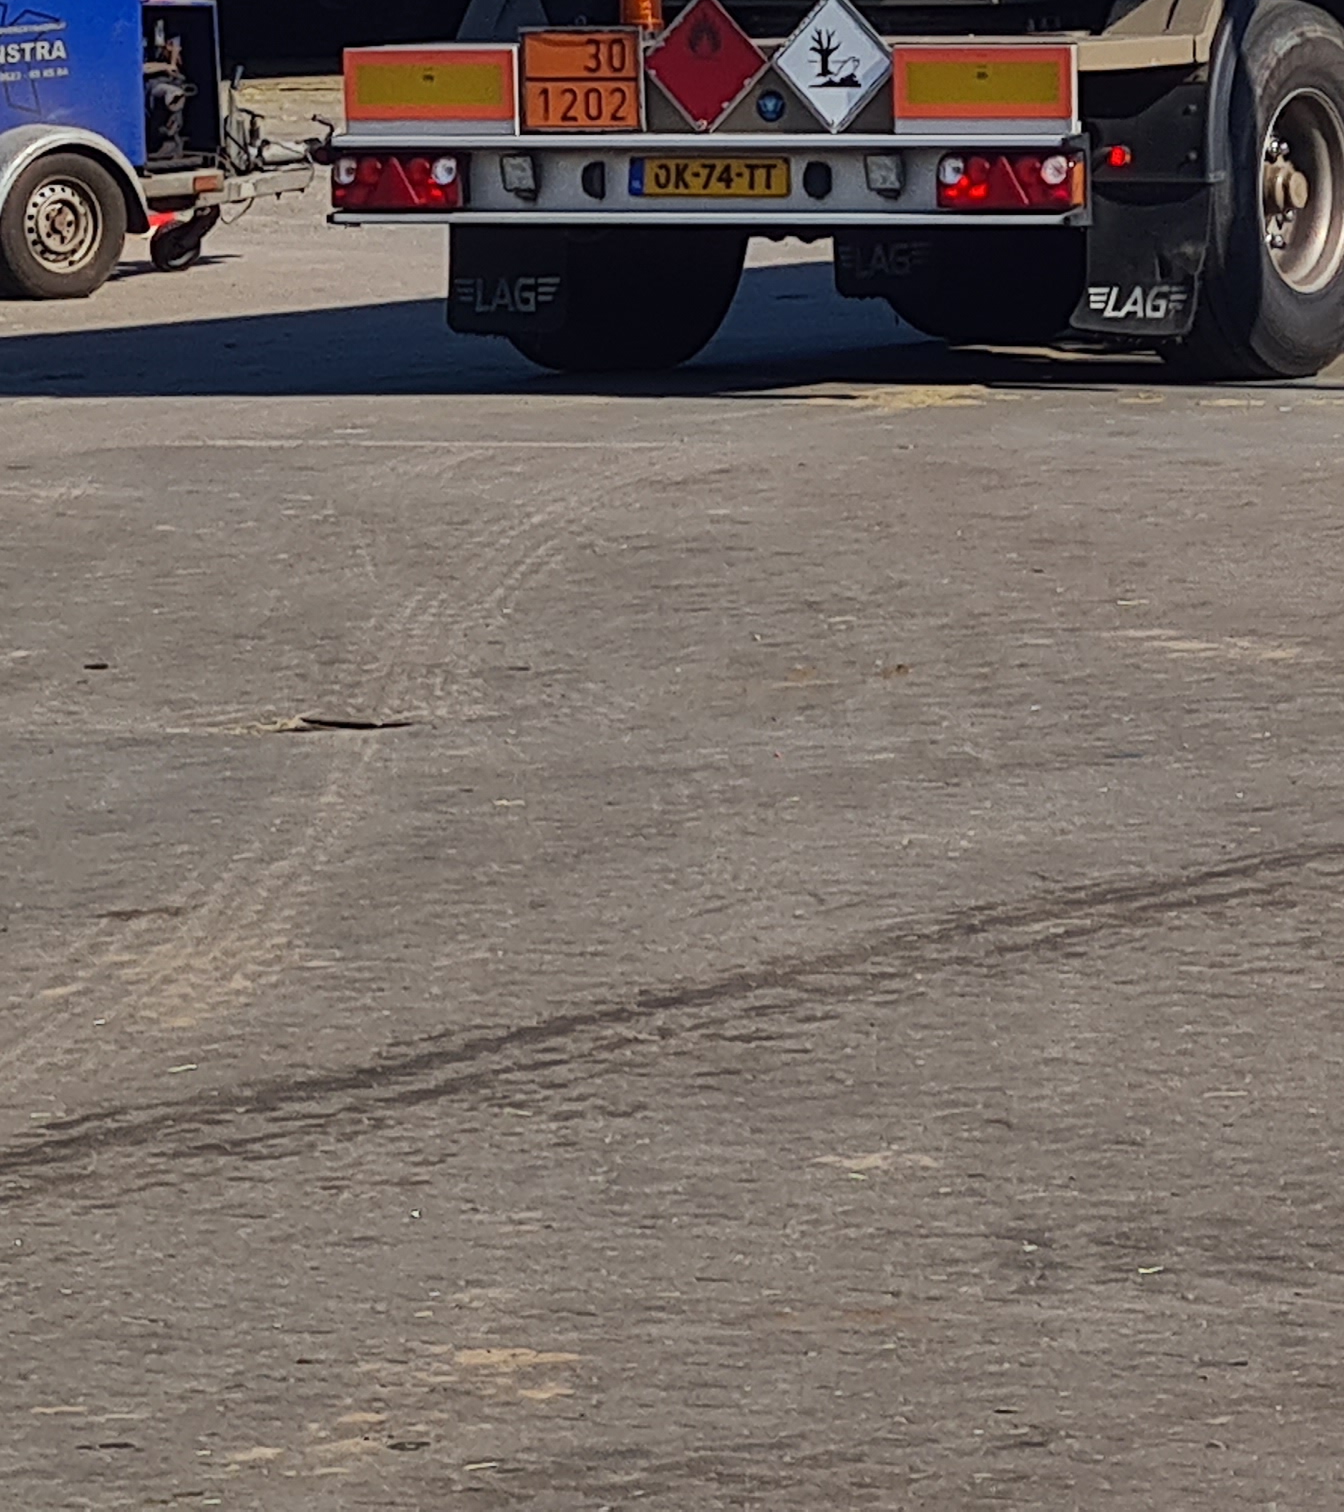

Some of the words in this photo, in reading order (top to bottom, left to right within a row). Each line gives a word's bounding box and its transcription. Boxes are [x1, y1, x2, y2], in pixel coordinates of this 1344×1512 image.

[583, 38, 627, 73] 30
[538, 87, 627, 123] 1202
[654, 163, 778, 191] OK-74-TT
[475, 276, 536, 313] LAG
[1104, 286, 1170, 319] LAG
